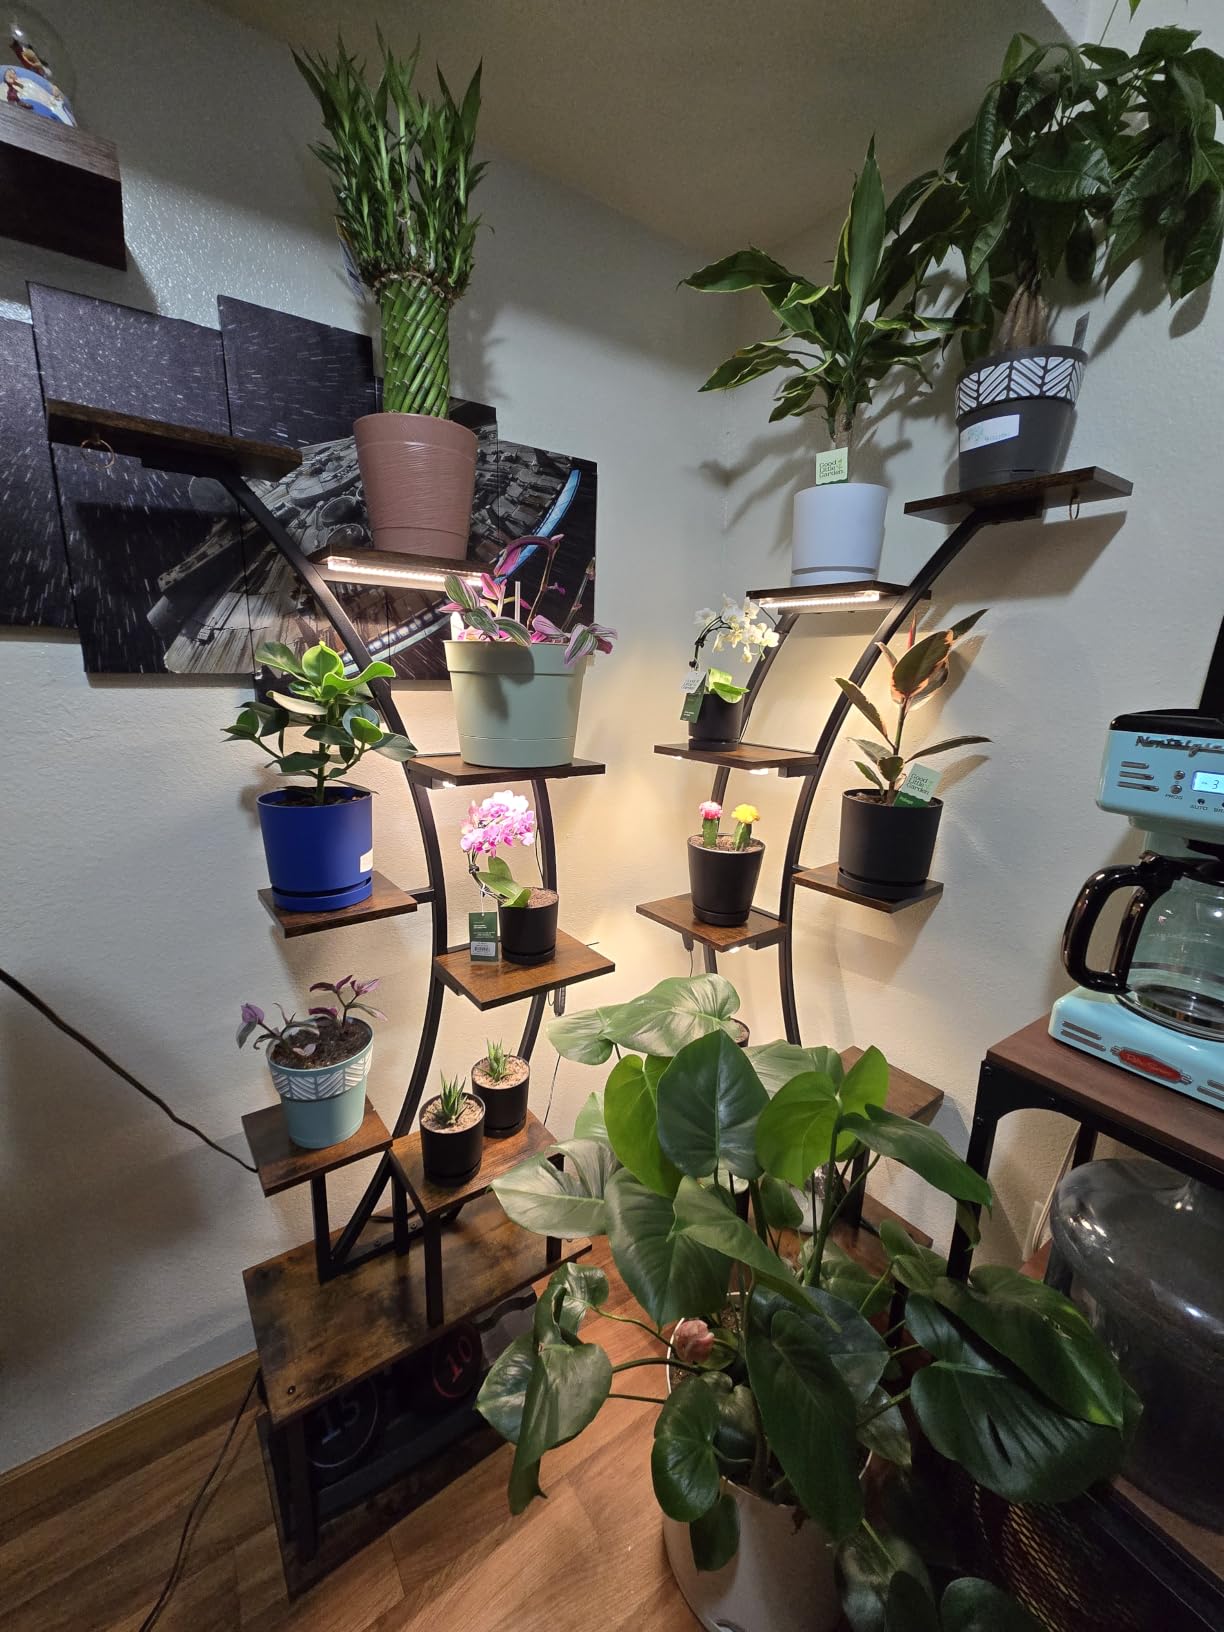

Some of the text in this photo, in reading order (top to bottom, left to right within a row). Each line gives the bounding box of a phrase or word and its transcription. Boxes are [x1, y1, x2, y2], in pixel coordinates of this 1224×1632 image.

[819, 459, 837, 468] Good
[819, 466, 836, 474] Little
[819, 469, 845, 478] Garden
[908, 777, 925, 788] Little
[910, 773, 929, 784] Good
[906, 783, 930, 795] Garden
